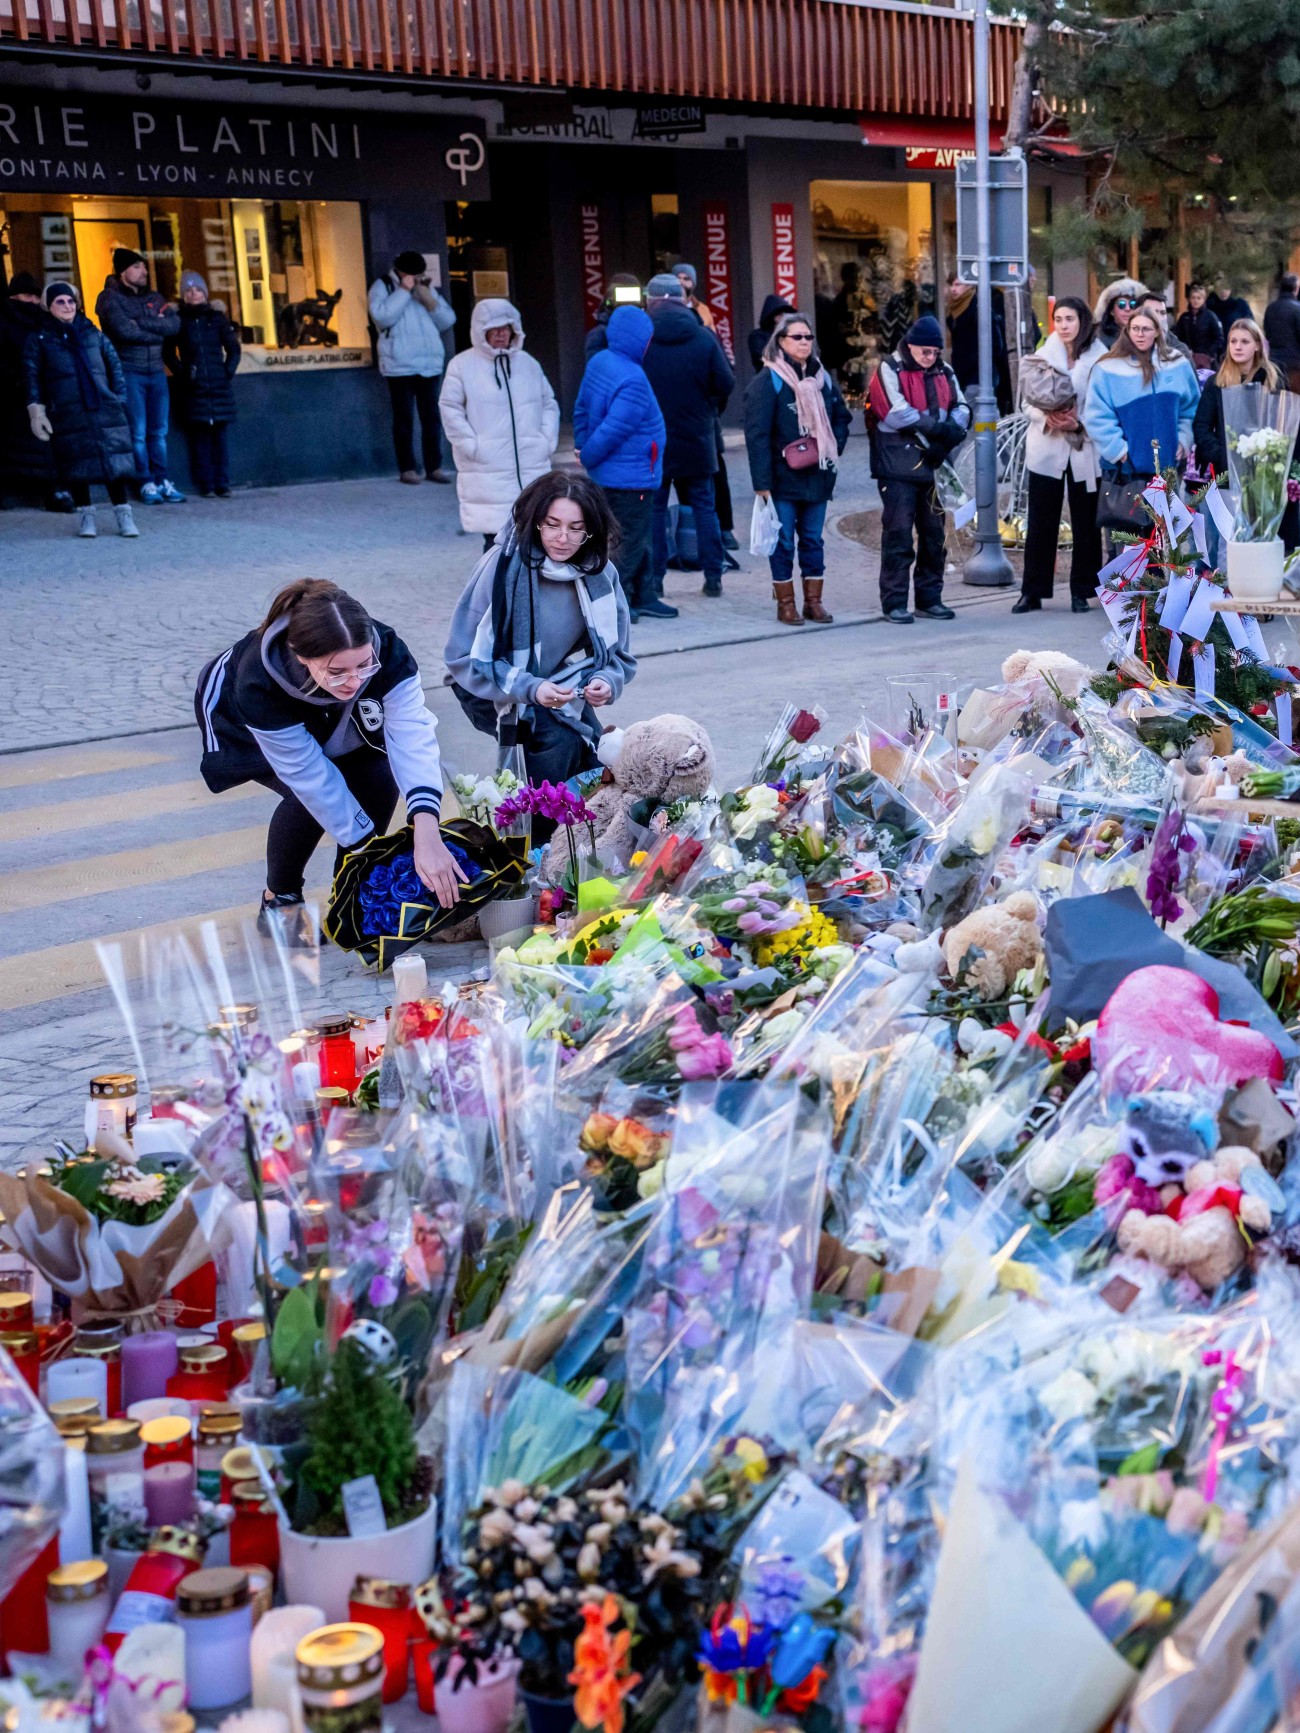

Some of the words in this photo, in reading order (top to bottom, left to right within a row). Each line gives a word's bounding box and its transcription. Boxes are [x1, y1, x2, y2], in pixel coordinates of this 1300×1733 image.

[132, 111, 361, 159] PLATINI
[641, 106, 701, 123] MEDECIN
[137, 164, 198, 183] LYON
[226, 168, 315, 187] ANNECY
[582, 205, 604, 301] AVENUE
[706, 213, 729, 311] AVENUE
[775, 213, 796, 305] AVENUE
[266, 353, 363, 366] GALERIE-PLATINI.COM
[357, 698, 384, 732] B
